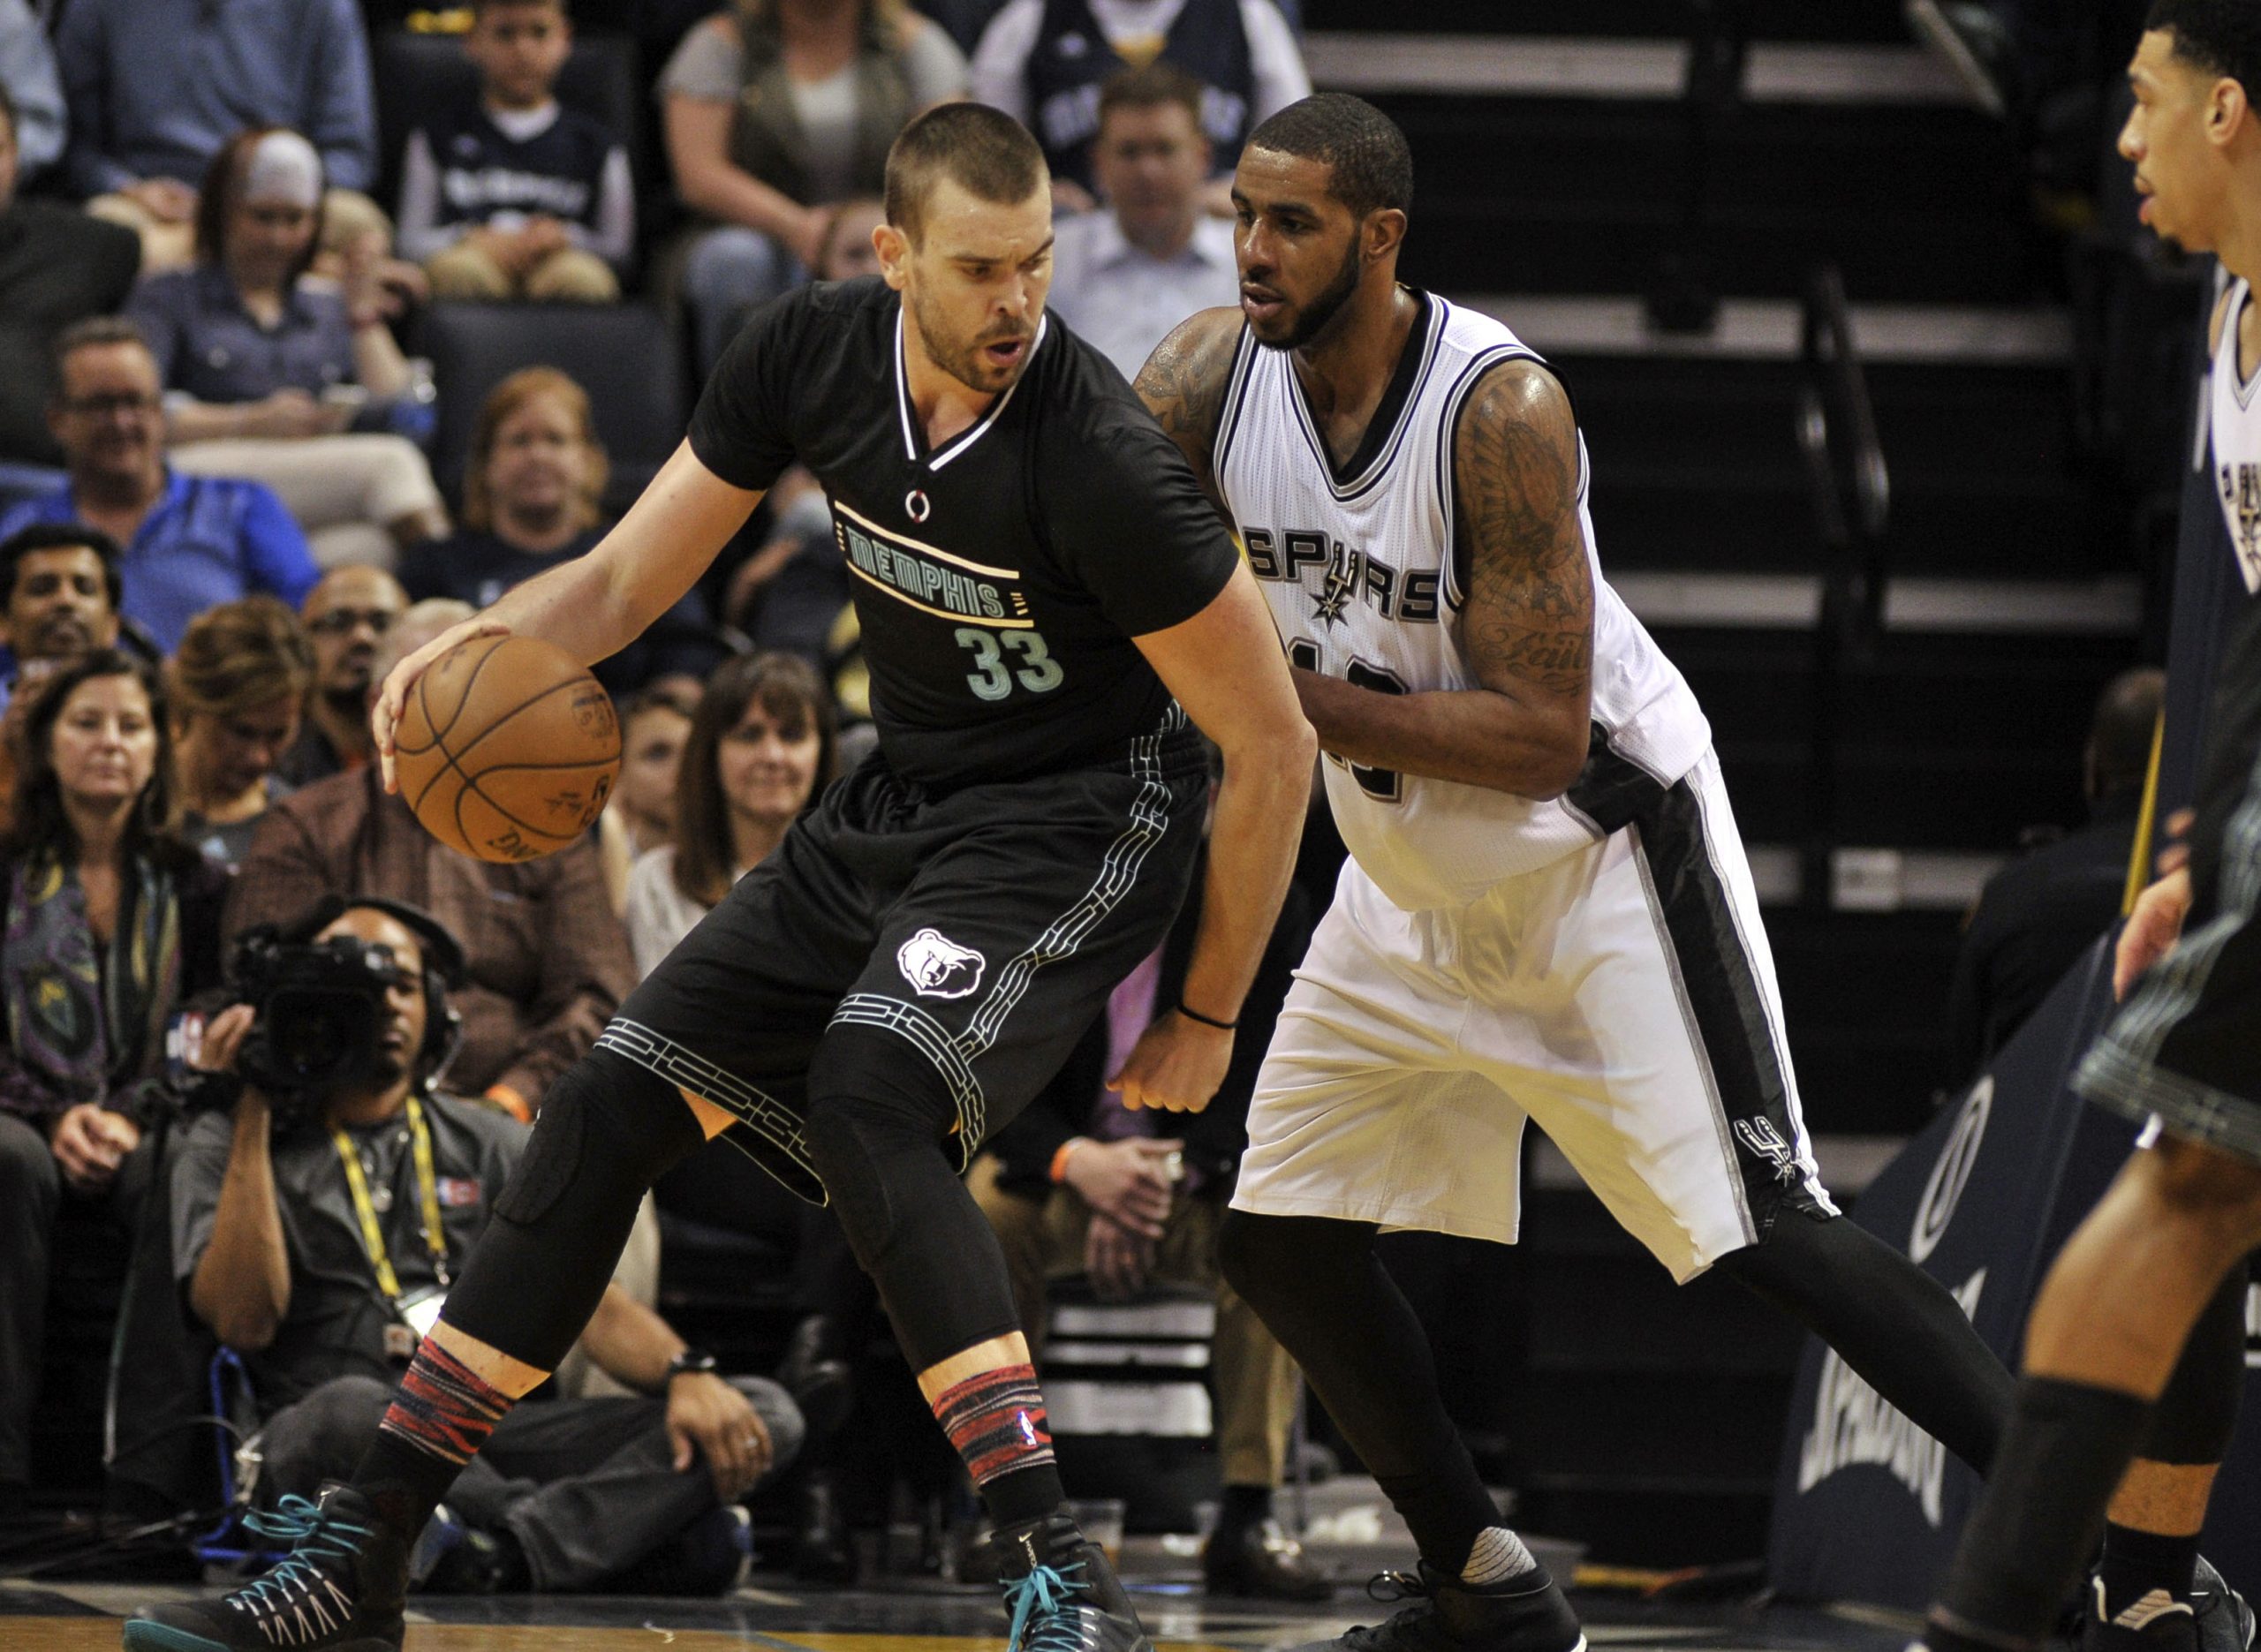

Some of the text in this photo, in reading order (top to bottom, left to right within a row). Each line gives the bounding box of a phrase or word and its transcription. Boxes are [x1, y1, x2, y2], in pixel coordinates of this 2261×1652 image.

[845, 524, 1005, 618] MEMPHIS
[1242, 526, 1441, 625] SPURS
[954, 628, 1064, 701] 33
